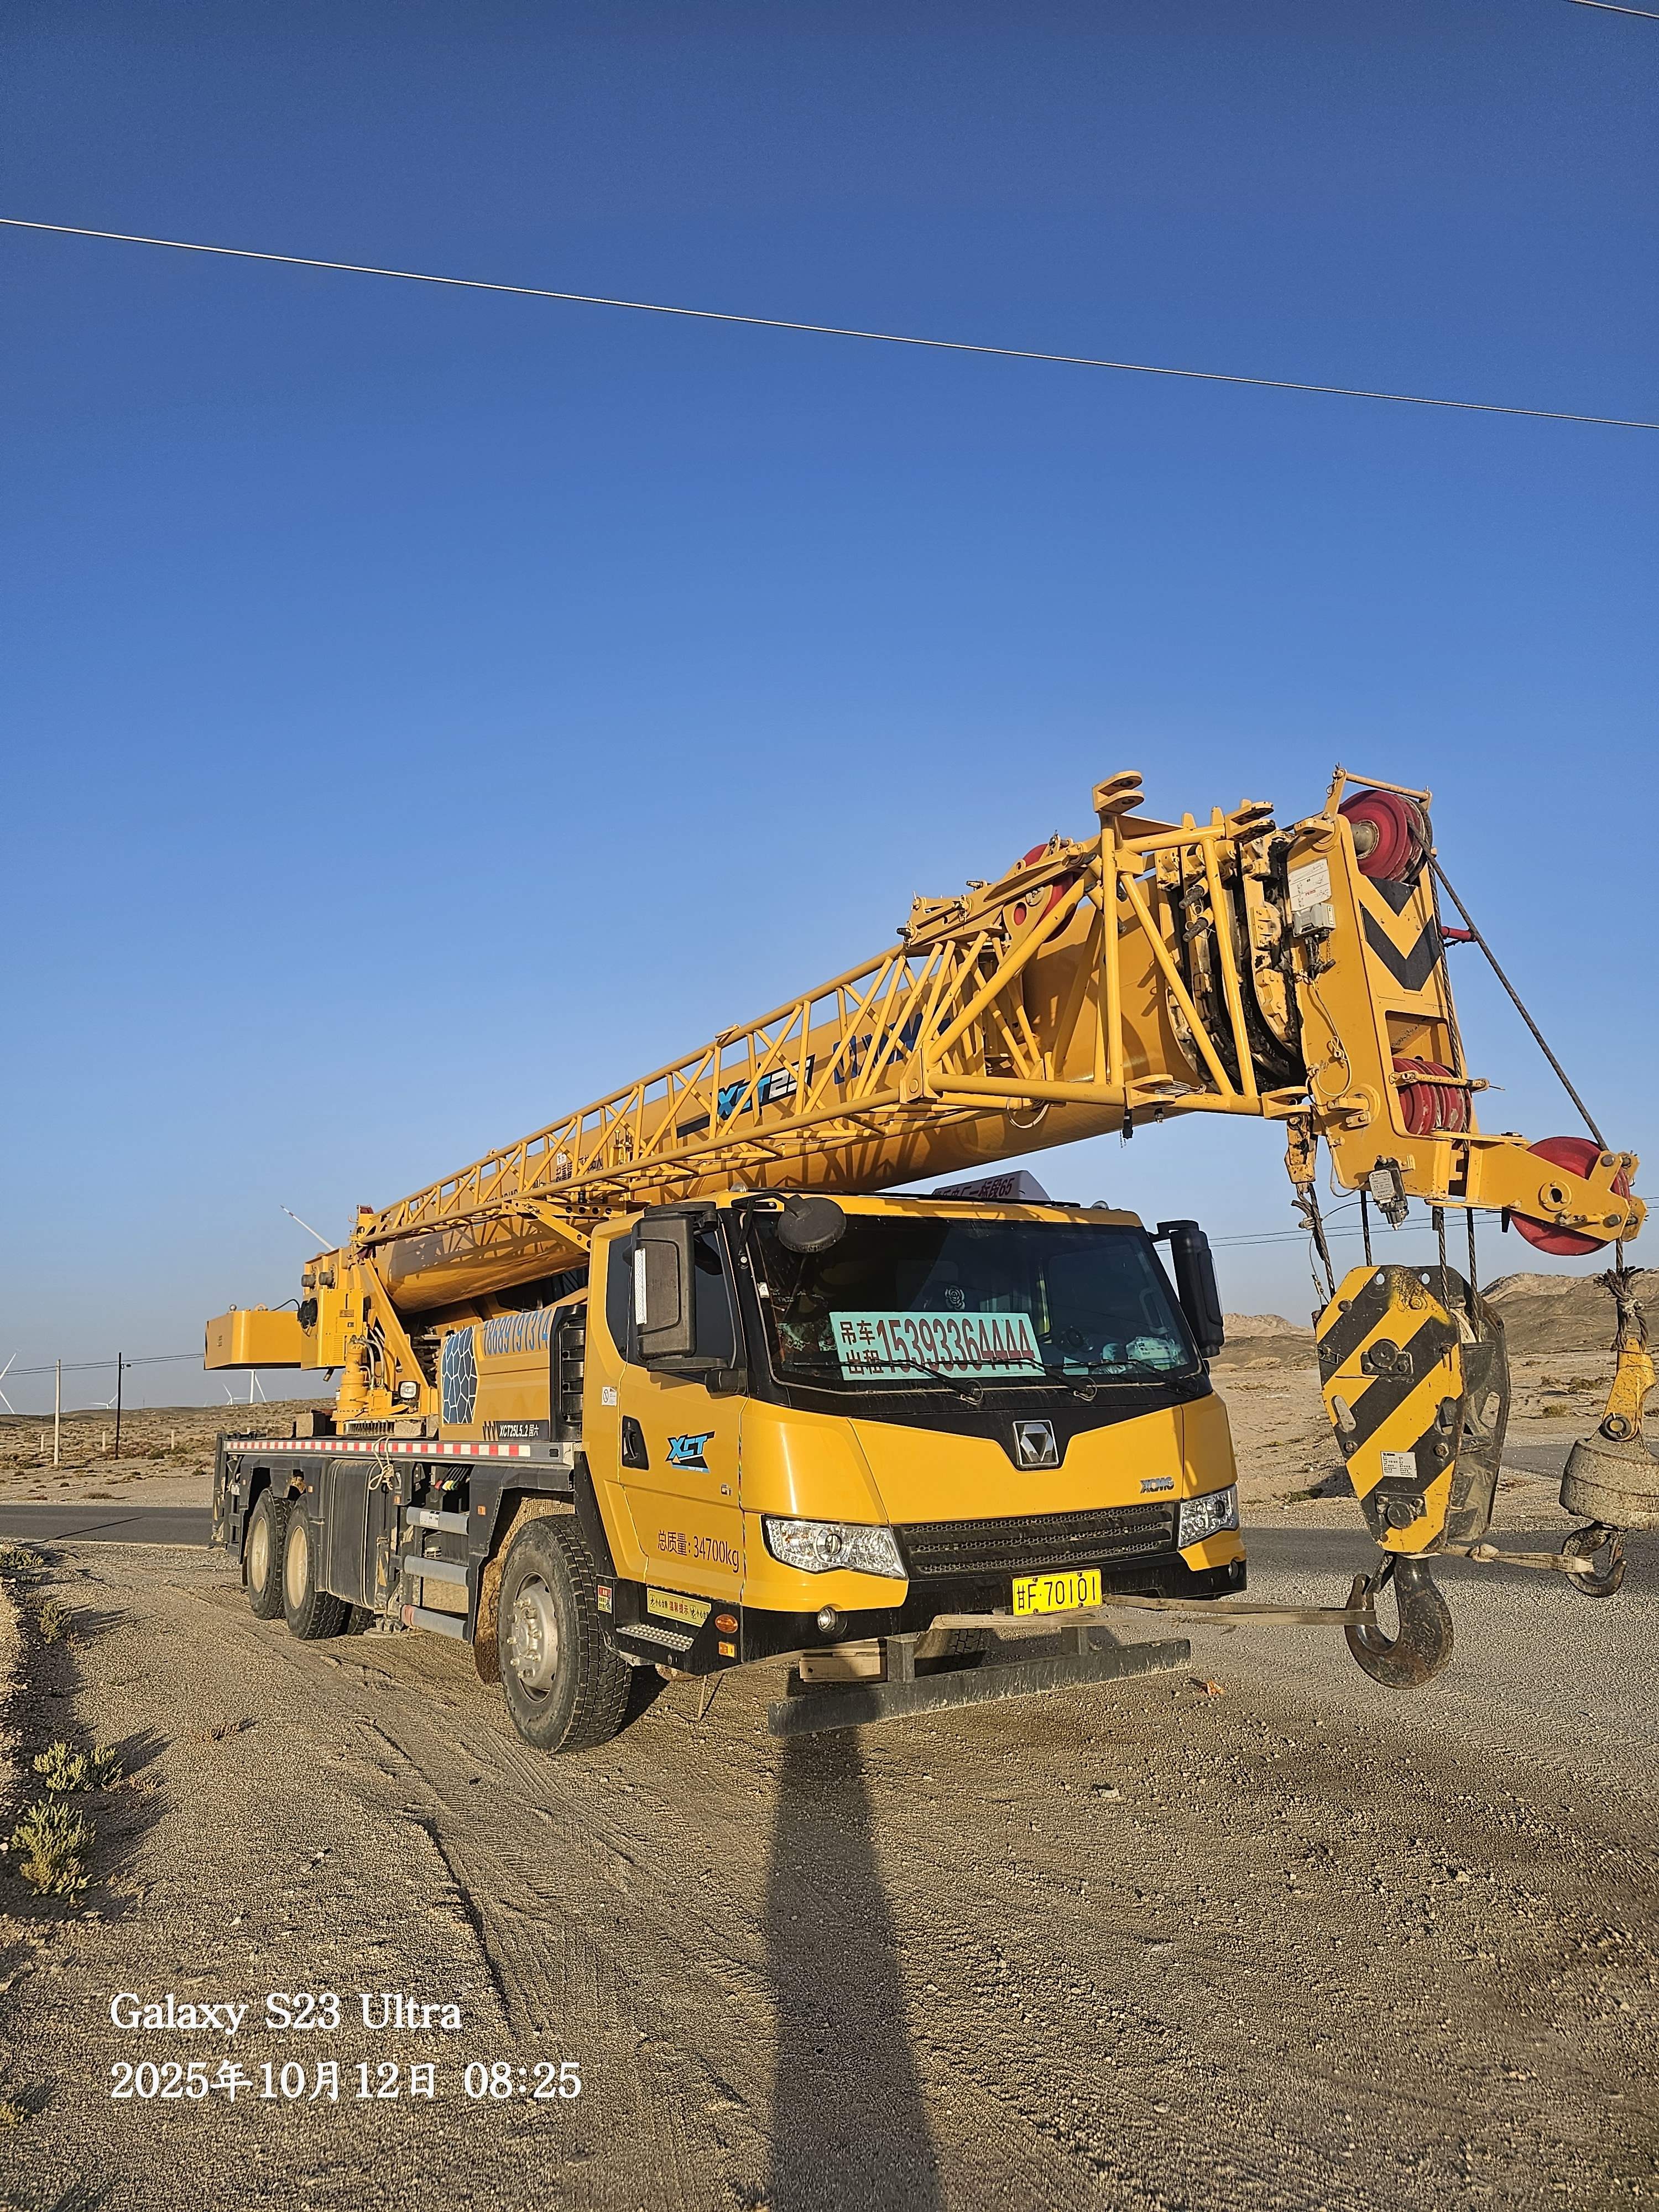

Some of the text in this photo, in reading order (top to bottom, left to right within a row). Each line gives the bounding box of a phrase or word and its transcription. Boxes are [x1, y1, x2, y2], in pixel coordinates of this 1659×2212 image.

[484, 1308, 552, 1356] 18689191314
[840, 1319, 876, 1345] 吊车
[876, 1318, 1036, 1373] 15393364444
[845, 1349, 884, 1375] 出租
[668, 1435, 708, 1459] XCT
